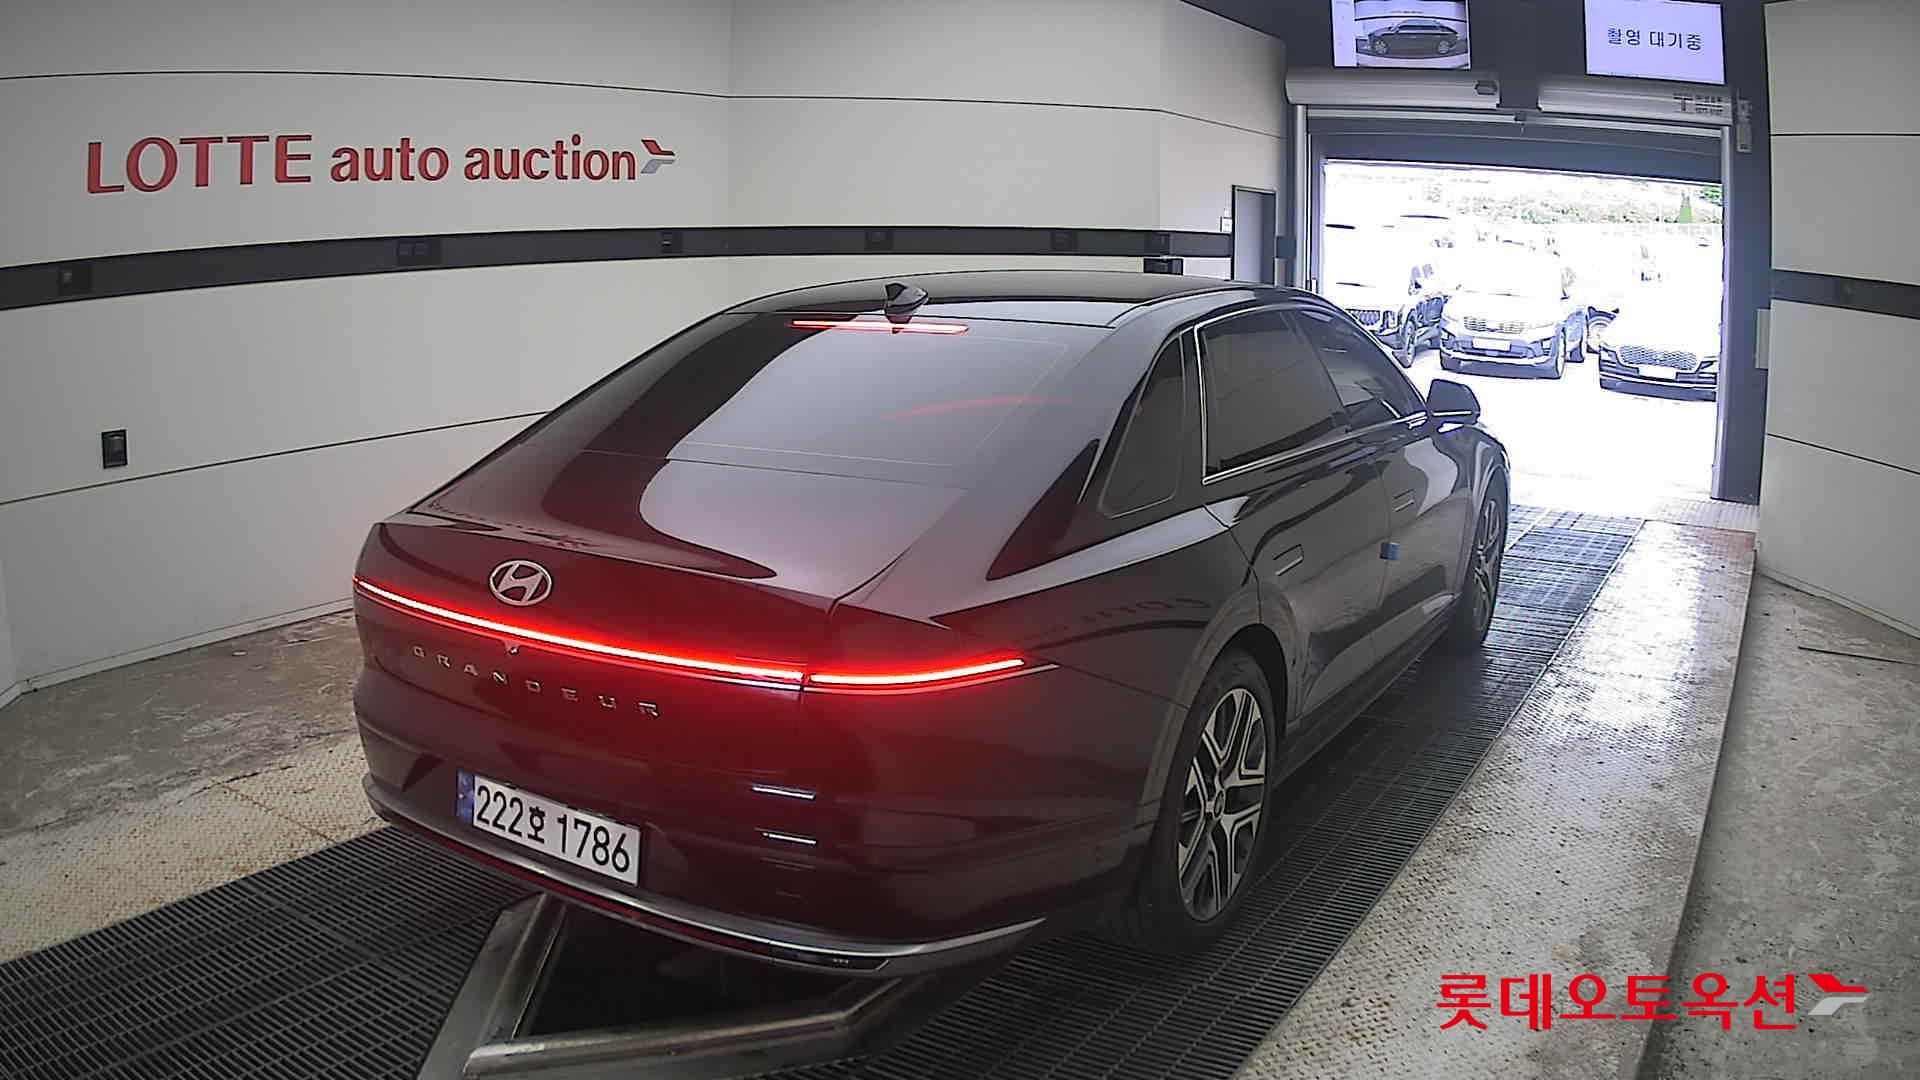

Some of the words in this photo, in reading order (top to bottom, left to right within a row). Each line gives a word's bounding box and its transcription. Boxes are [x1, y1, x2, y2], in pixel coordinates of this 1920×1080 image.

[1607, 27, 1641, 46] 촬영
[1649, 31, 1702, 51] 대기중
[87, 134, 312, 194] LOTTE
[330, 137, 449, 182] auto
[463, 133, 636, 181] auction
[413, 645, 661, 718] GRANDEUR
[476, 785, 546, 845] 222호
[557, 813, 631, 873] 1786
